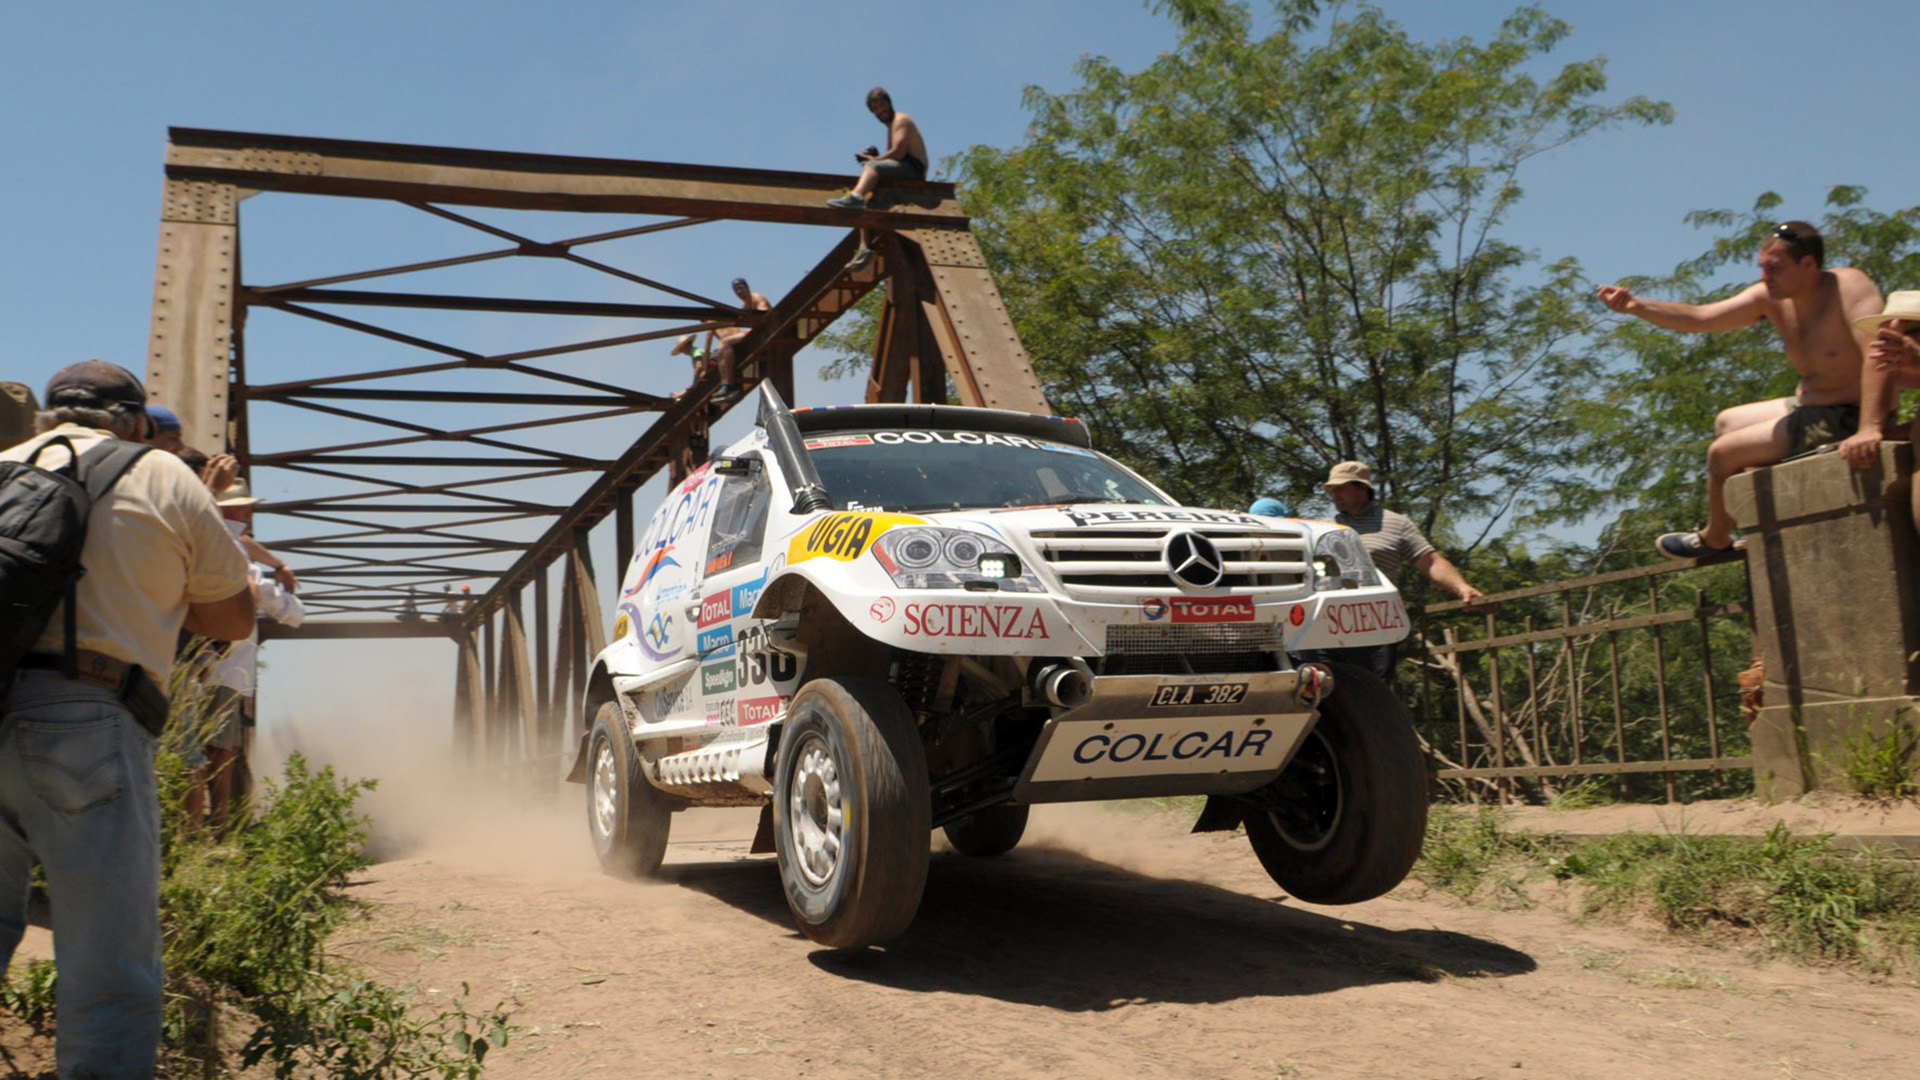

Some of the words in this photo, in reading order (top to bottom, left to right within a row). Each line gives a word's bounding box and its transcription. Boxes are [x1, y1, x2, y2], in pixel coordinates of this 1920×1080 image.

[873, 431, 1039, 449] COLCAR
[1066, 511, 1265, 527] PEREIRA
[807, 515, 873, 560] VIGIA
[739, 587, 760, 609] Mac
[1173, 602, 1252, 616] TOTAL
[702, 600, 730, 622] TOTAL
[903, 603, 1050, 639] SCIENZA
[1326, 600, 1404, 635] SCIENZA
[1156, 686, 1194, 705] CLA
[1204, 684, 1243, 703] 382
[742, 703, 777, 720] TOTAL
[1073, 729, 1273, 764] COLCAR
